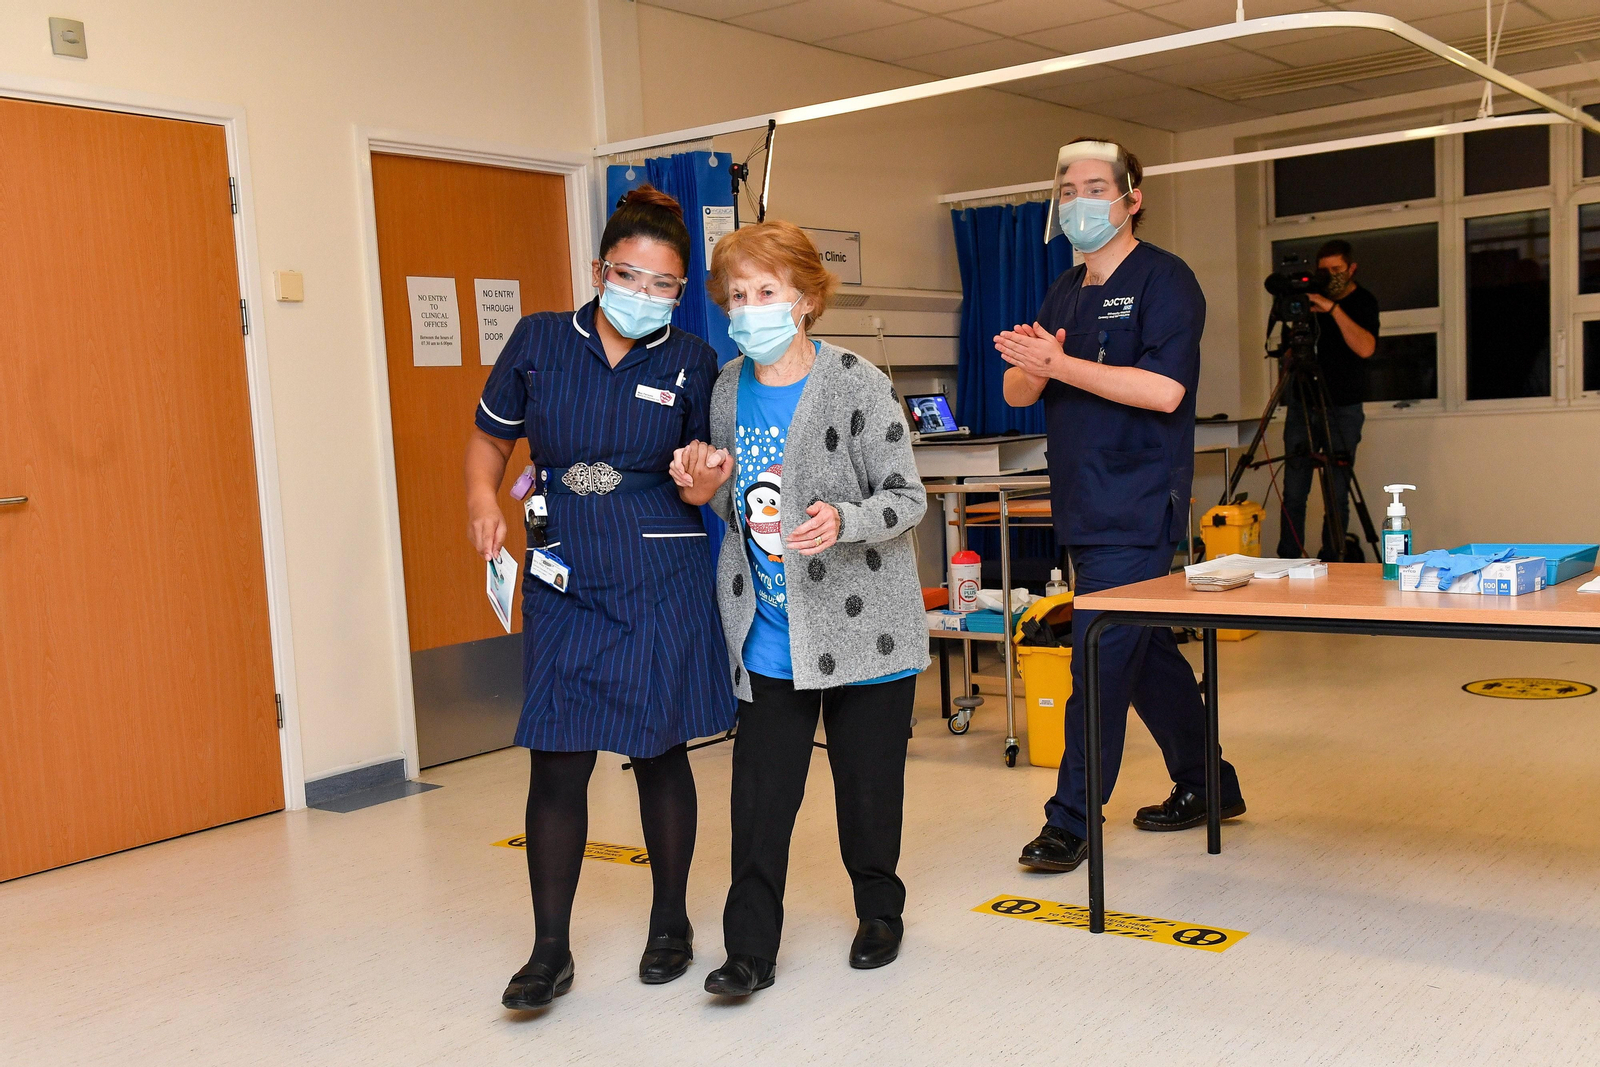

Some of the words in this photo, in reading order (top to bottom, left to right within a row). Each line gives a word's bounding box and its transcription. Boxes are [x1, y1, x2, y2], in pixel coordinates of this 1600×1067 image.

[825, 251, 847, 262] Clinic
[483, 290, 493, 298] NO
[482, 304, 514, 312] THROUGH
[1115, 924, 1158, 933] DISTANCE
